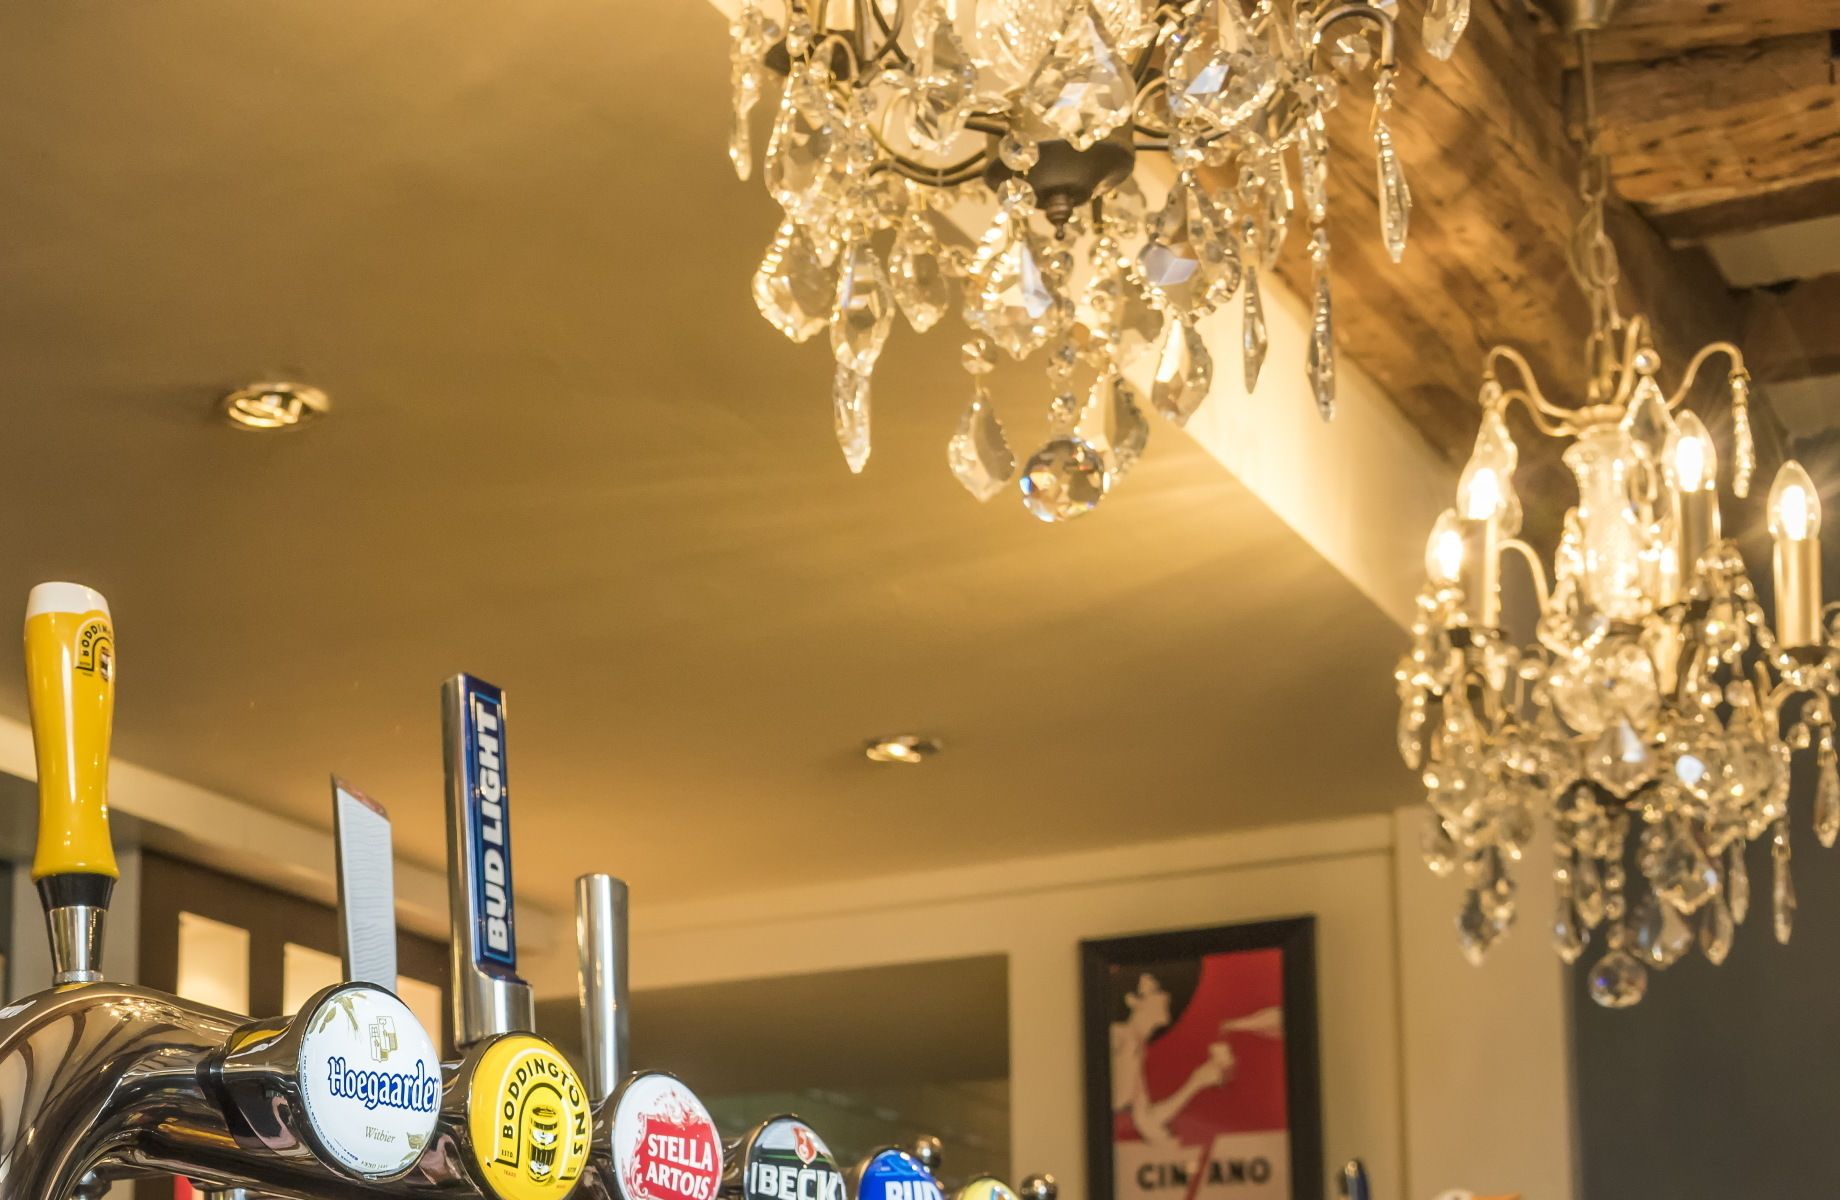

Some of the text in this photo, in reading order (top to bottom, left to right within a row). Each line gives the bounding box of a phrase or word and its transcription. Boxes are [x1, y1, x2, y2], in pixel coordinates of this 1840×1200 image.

[476, 701, 508, 952] BUD LIGHT
[328, 1056, 441, 1113] Hoegaarden
[502, 1058, 587, 1156] BODDINGTONS
[365, 1126, 396, 1144] Witbier
[647, 1133, 713, 1173] STELLA
[645, 1160, 712, 1200] ARTOIS
